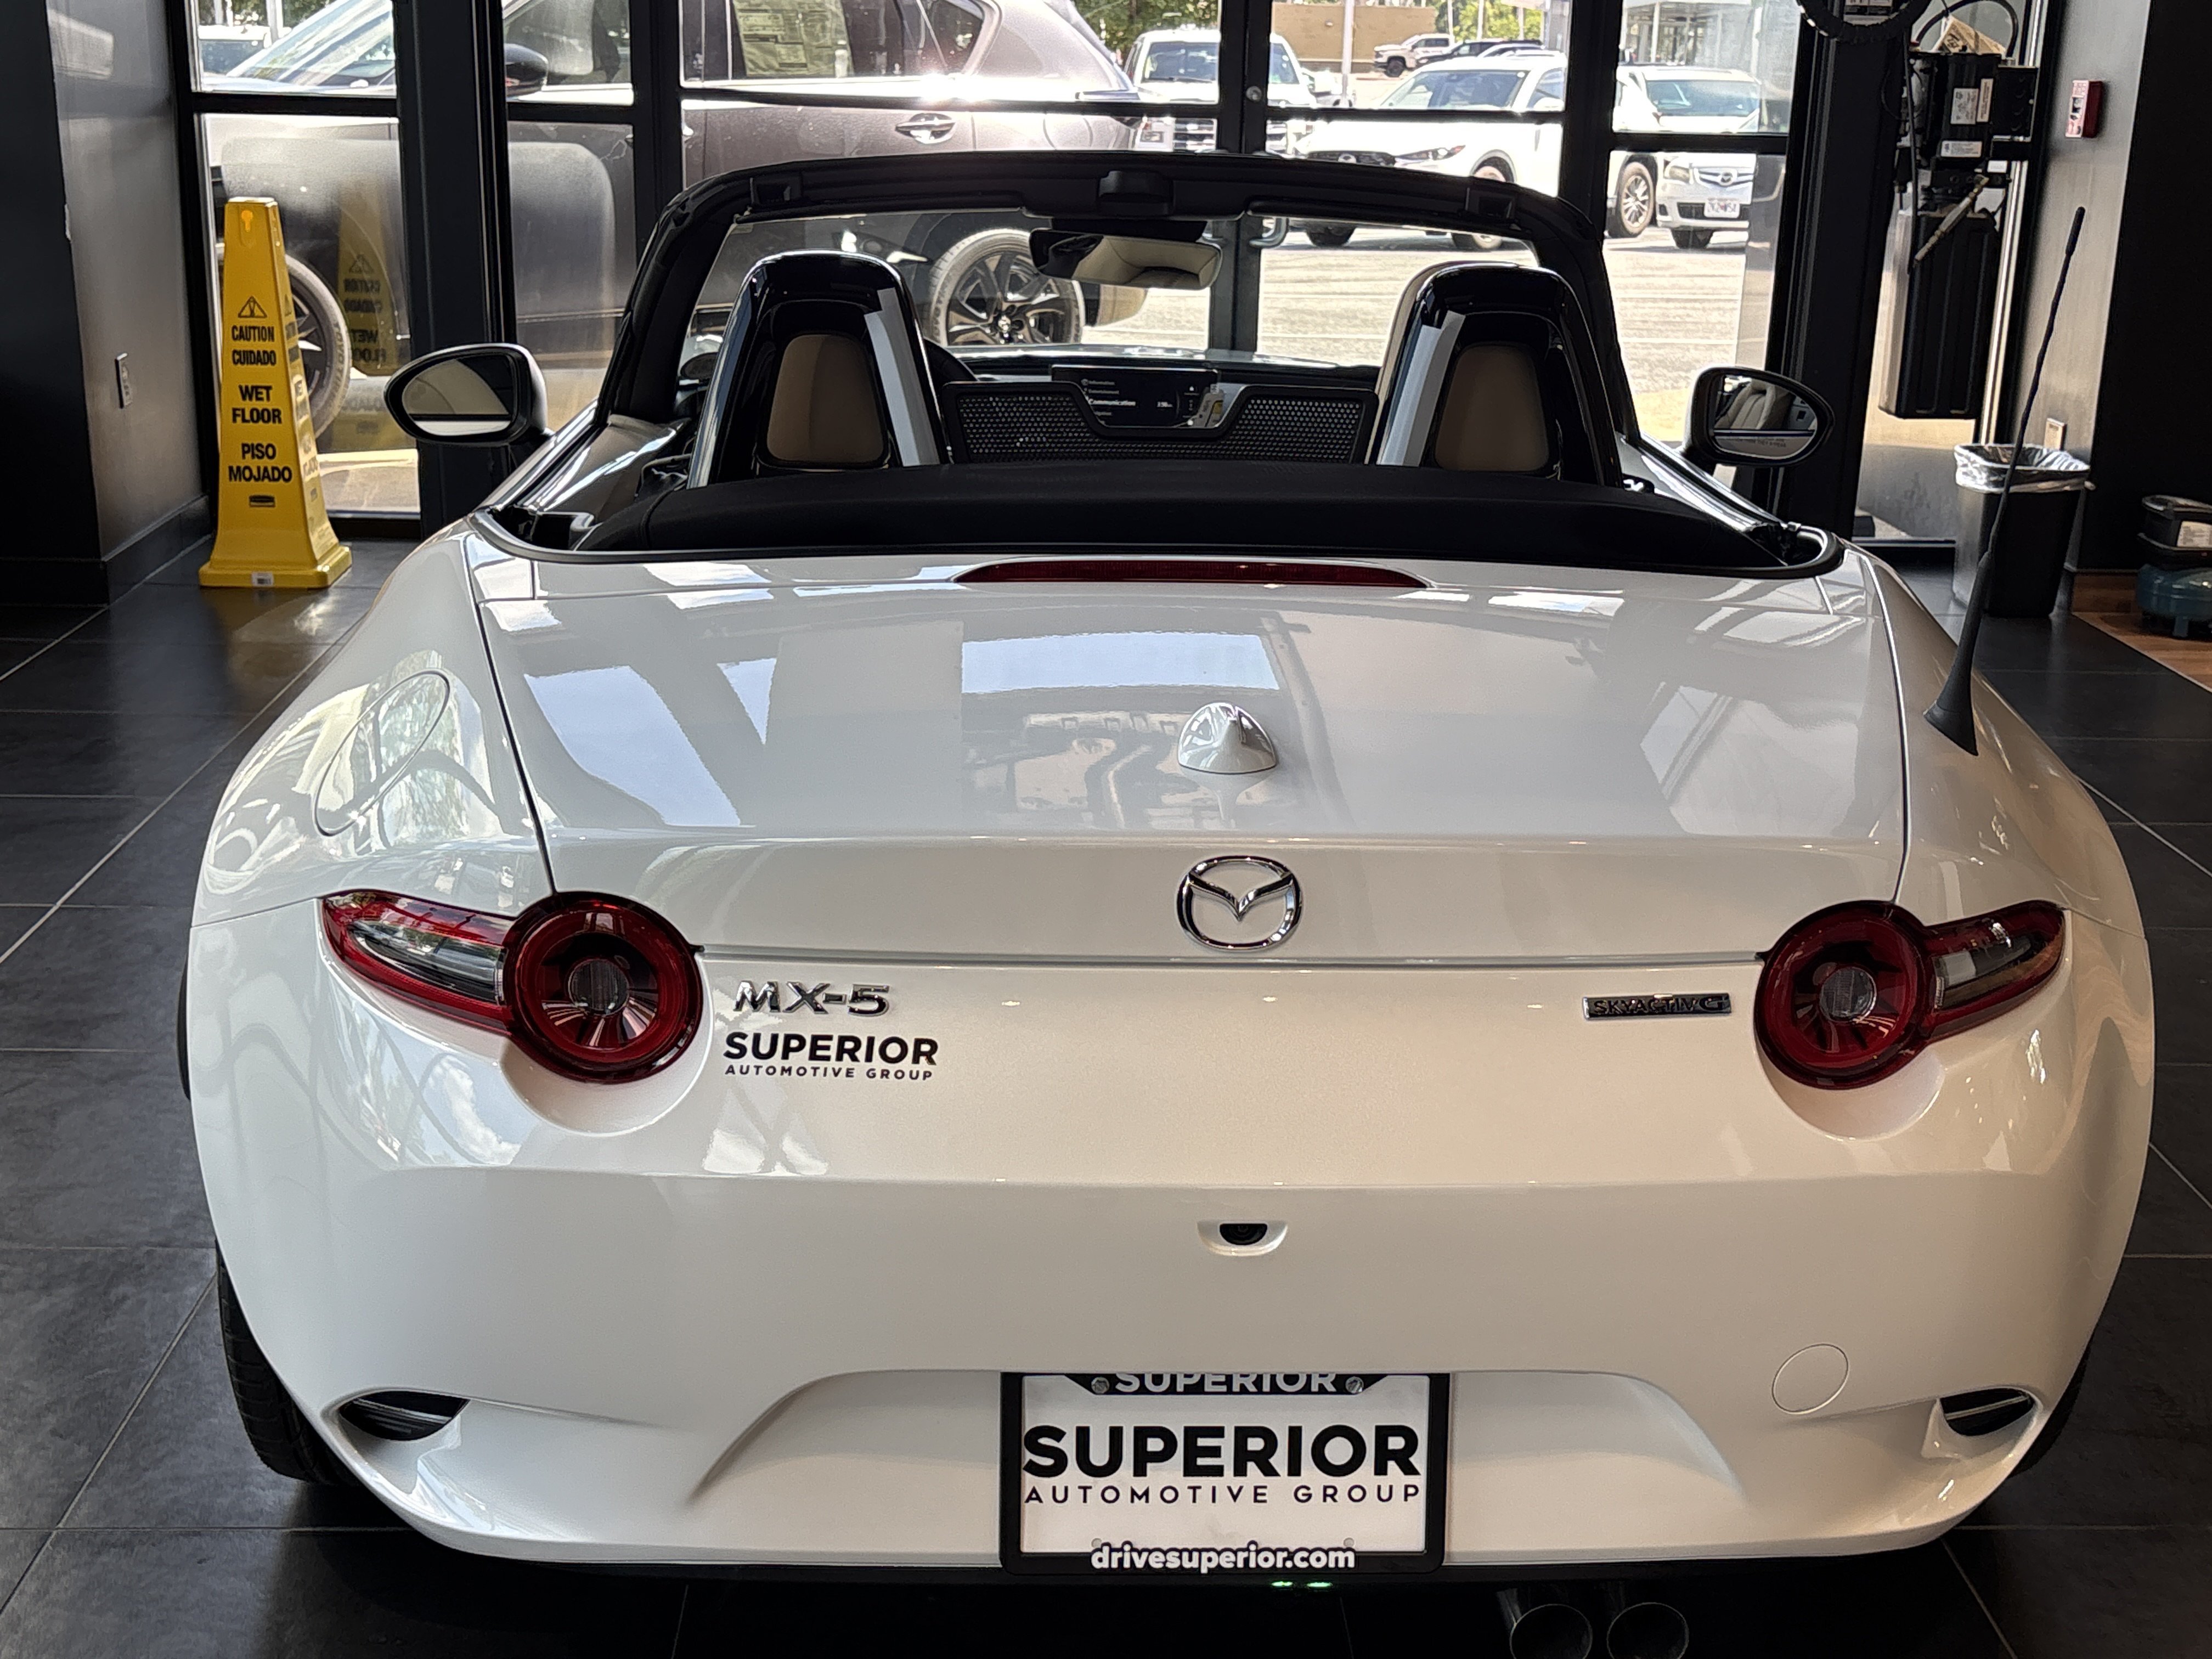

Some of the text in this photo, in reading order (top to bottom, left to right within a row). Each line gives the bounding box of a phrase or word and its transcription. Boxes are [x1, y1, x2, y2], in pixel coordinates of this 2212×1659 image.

[232, 325, 274, 342] CAUTION
[232, 349, 276, 366] CUIDADO
[239, 385, 272, 402] WET
[232, 408, 282, 424] FLOOR
[241, 443, 276, 460] PISO
[228, 465, 292, 483] MOJADO
[733, 980, 890, 1017] MX-5
[1594, 997, 1699, 1014] SKYACTIV
[724, 1032, 939, 1065] SUPERIOR
[725, 1065, 933, 1080] AUTOMOTIVE GROUP
[1115, 1373, 1336, 1392] SUPERIOR
[1022, 1425, 1421, 1477] SUPERIOR
[1025, 1485, 1419, 1504] AUTOMOTIVE GROUP
[1091, 1544, 1355, 1573] drivesuperior.com
